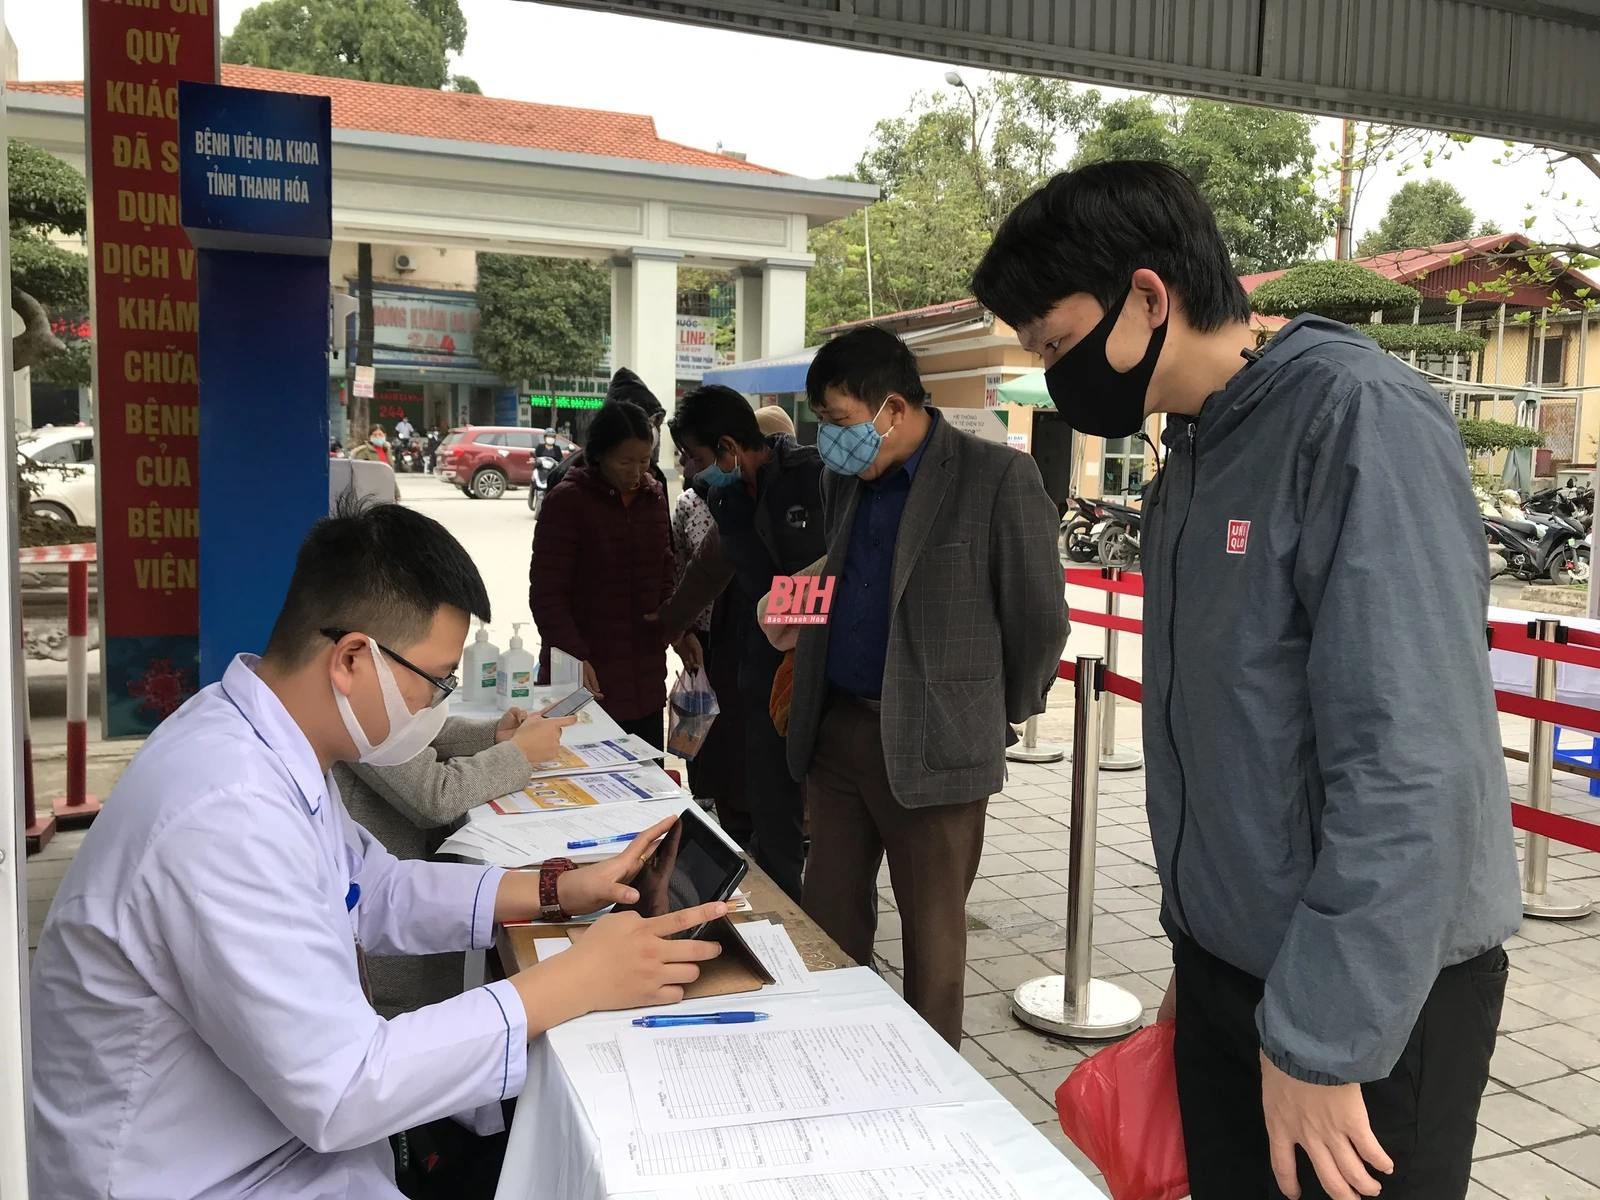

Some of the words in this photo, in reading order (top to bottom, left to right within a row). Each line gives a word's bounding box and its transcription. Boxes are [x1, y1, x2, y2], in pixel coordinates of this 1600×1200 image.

[126, 27, 180, 66] QUÝ
[106, 79, 178, 120] KHÁC
[112, 131, 152, 171] ĐÃ
[161, 140, 179, 173] S
[195, 127, 231, 160] BỆNH
[233, 130, 263, 164] VIỆN
[265, 138, 284, 162] ĐA
[286, 139, 320, 166] KHOA
[206, 164, 237, 198] TỈNH
[240, 174, 282, 203] THANH
[284, 175, 310, 204] HÓA
[118, 189, 179, 231] DỤN
[102, 242, 170, 283] DỊCH
[178, 247, 196, 280] V
[118, 293, 199, 332] KHÁM
[374, 300, 407, 329] HÒNG
[680, 330, 705, 345] LINH
[124, 344, 199, 384] CHỮA
[125, 397, 199, 442] BỆNH
[136, 443, 192, 487] CỦA
[128, 500, 200, 544] BỆNH
[1232, 525, 1247, 537] UNI
[1230, 537, 1245, 550] QLO
[134, 552, 196, 596] VIỆN
